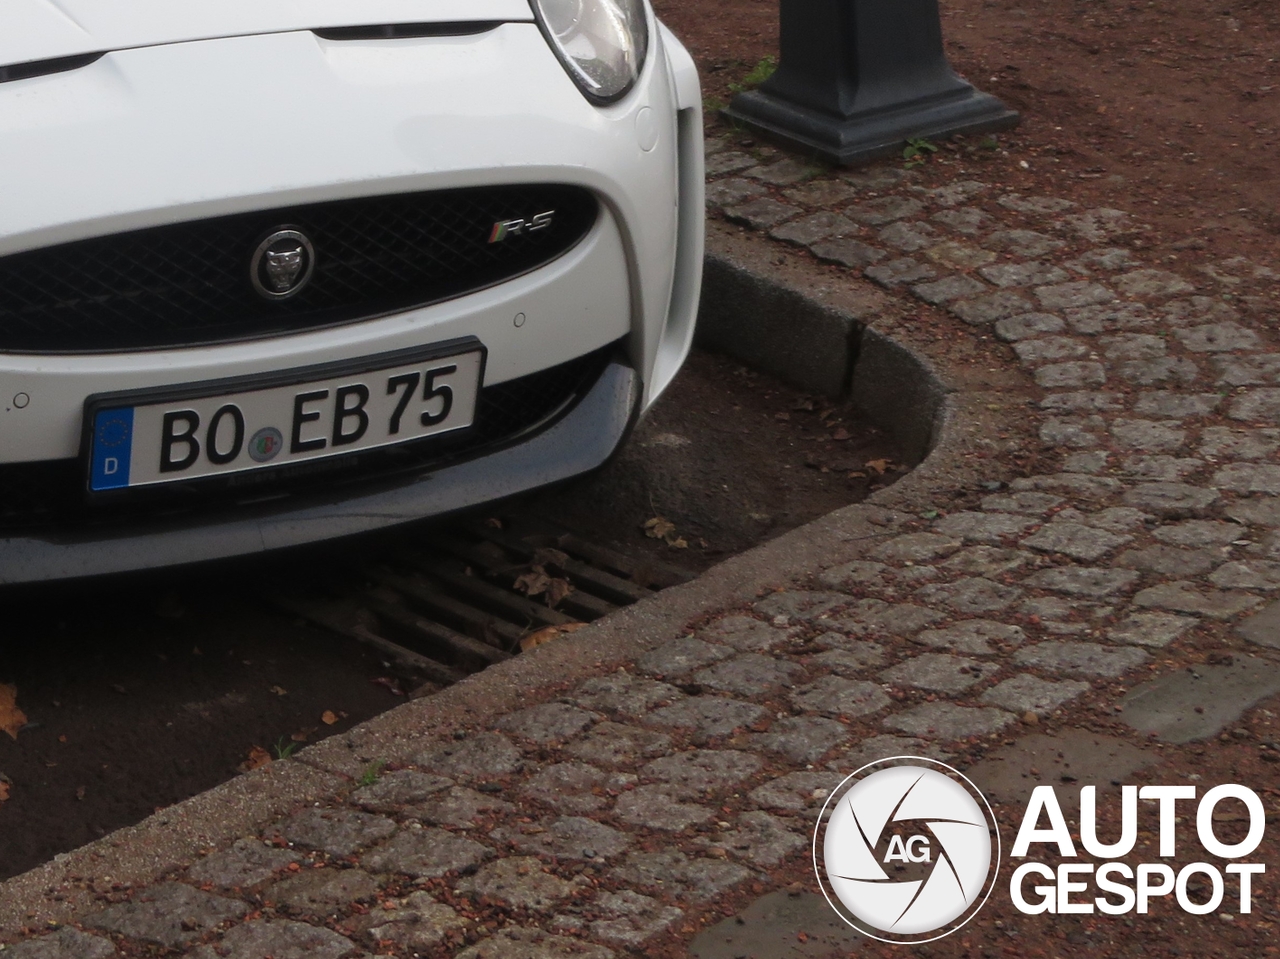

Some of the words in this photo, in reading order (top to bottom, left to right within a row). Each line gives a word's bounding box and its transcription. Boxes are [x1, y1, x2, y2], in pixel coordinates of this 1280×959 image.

[159, 404, 245, 474] BO
[289, 383, 370, 454] EB
[386, 364, 458, 436] 75
[103, 457, 118, 476] D
